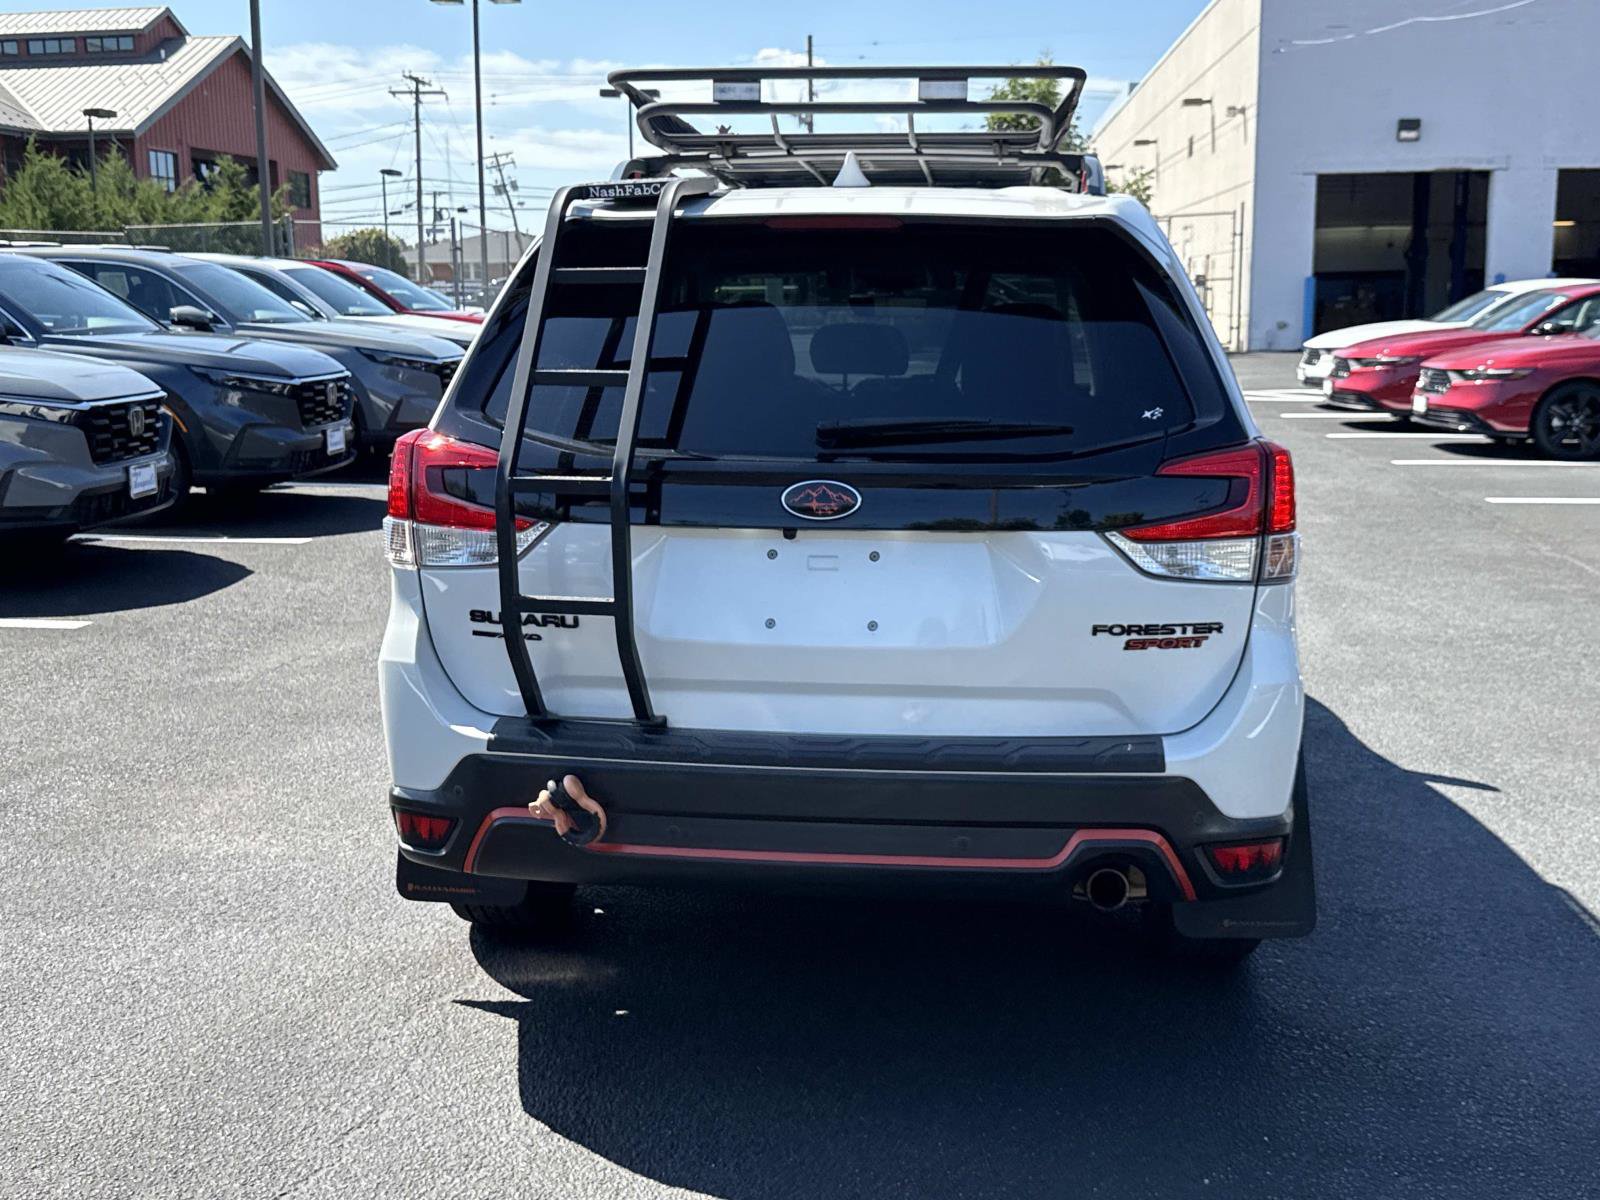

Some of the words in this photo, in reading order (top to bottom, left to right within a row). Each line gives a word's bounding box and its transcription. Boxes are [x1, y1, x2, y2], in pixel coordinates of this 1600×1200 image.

[469, 609, 580, 629] SUARU
[1092, 622, 1224, 637] FORESTER
[1123, 636, 1209, 651] SPORT
